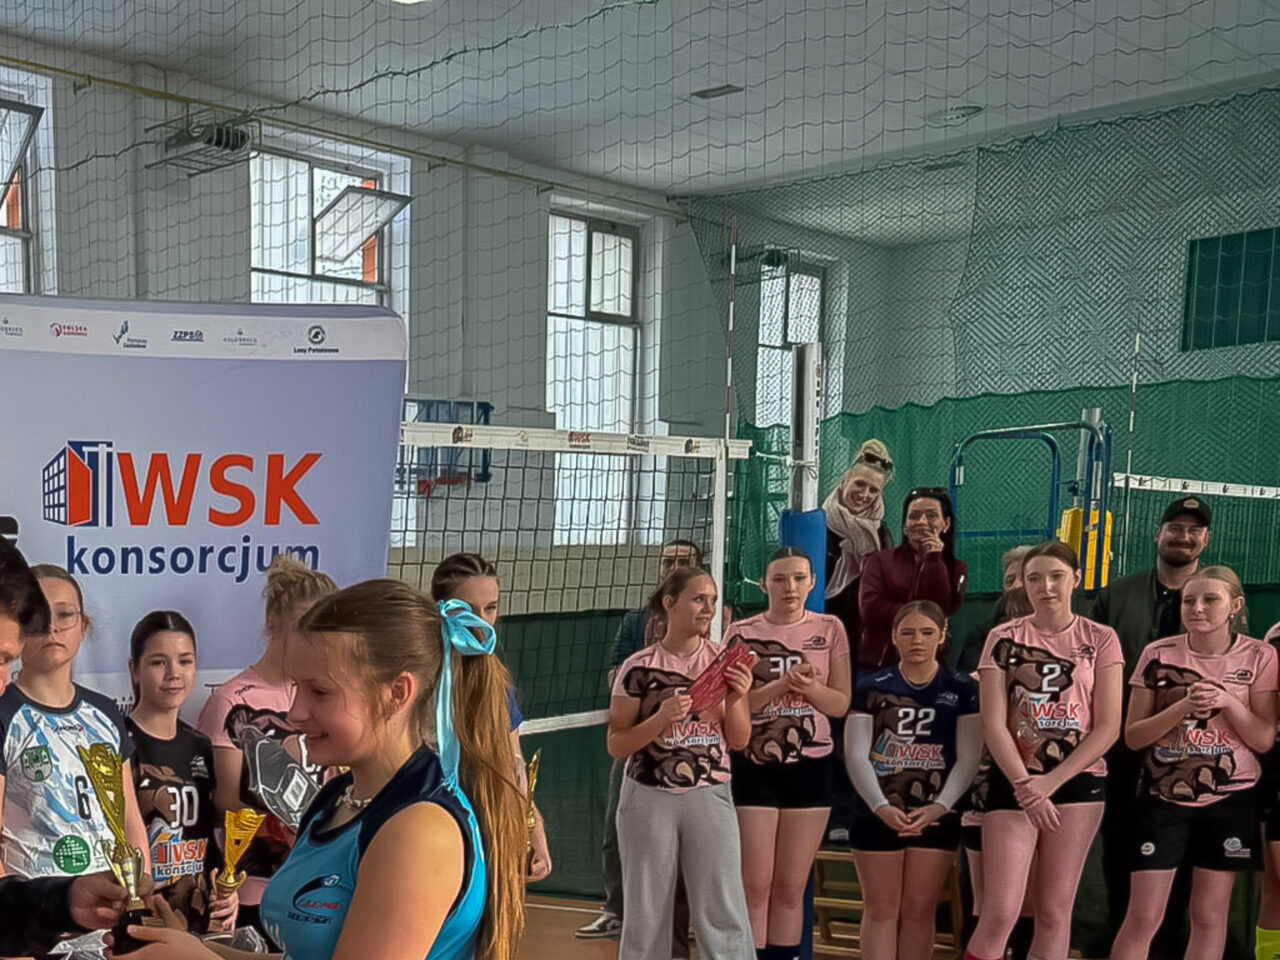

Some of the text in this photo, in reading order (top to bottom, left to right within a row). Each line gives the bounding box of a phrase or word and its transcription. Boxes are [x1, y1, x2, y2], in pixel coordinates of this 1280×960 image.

[117, 451, 322, 527] WSK
[67, 535, 320, 583] konsorcjum
[1042, 664, 1061, 692] 2
[897, 708, 936, 735] 22
[1032, 703, 1080, 717] WSK
[899, 744, 943, 759] WSK
[75, 775, 91, 820] 6
[167, 786, 199, 828] 30
